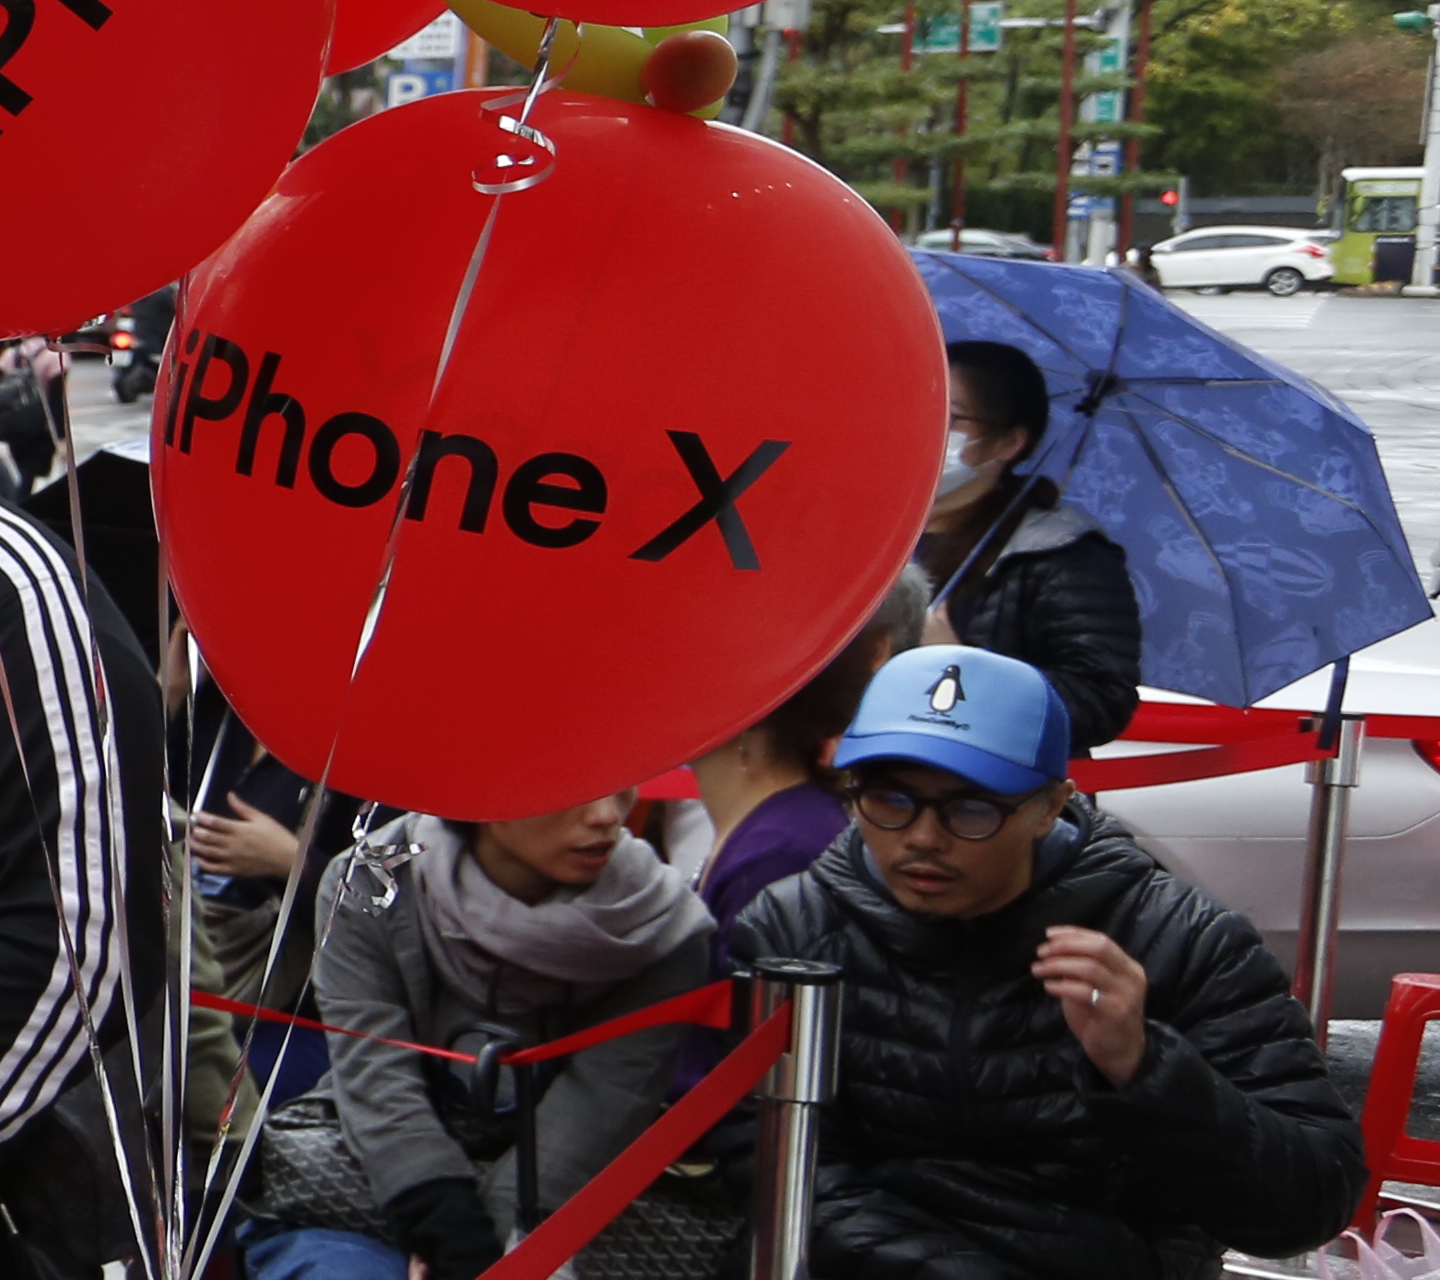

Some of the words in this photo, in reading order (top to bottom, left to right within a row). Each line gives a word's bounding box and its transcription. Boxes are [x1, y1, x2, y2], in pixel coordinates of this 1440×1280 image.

[386, 74, 427, 110] P
[164, 325, 609, 550] iPhone
[628, 429, 793, 572] X
